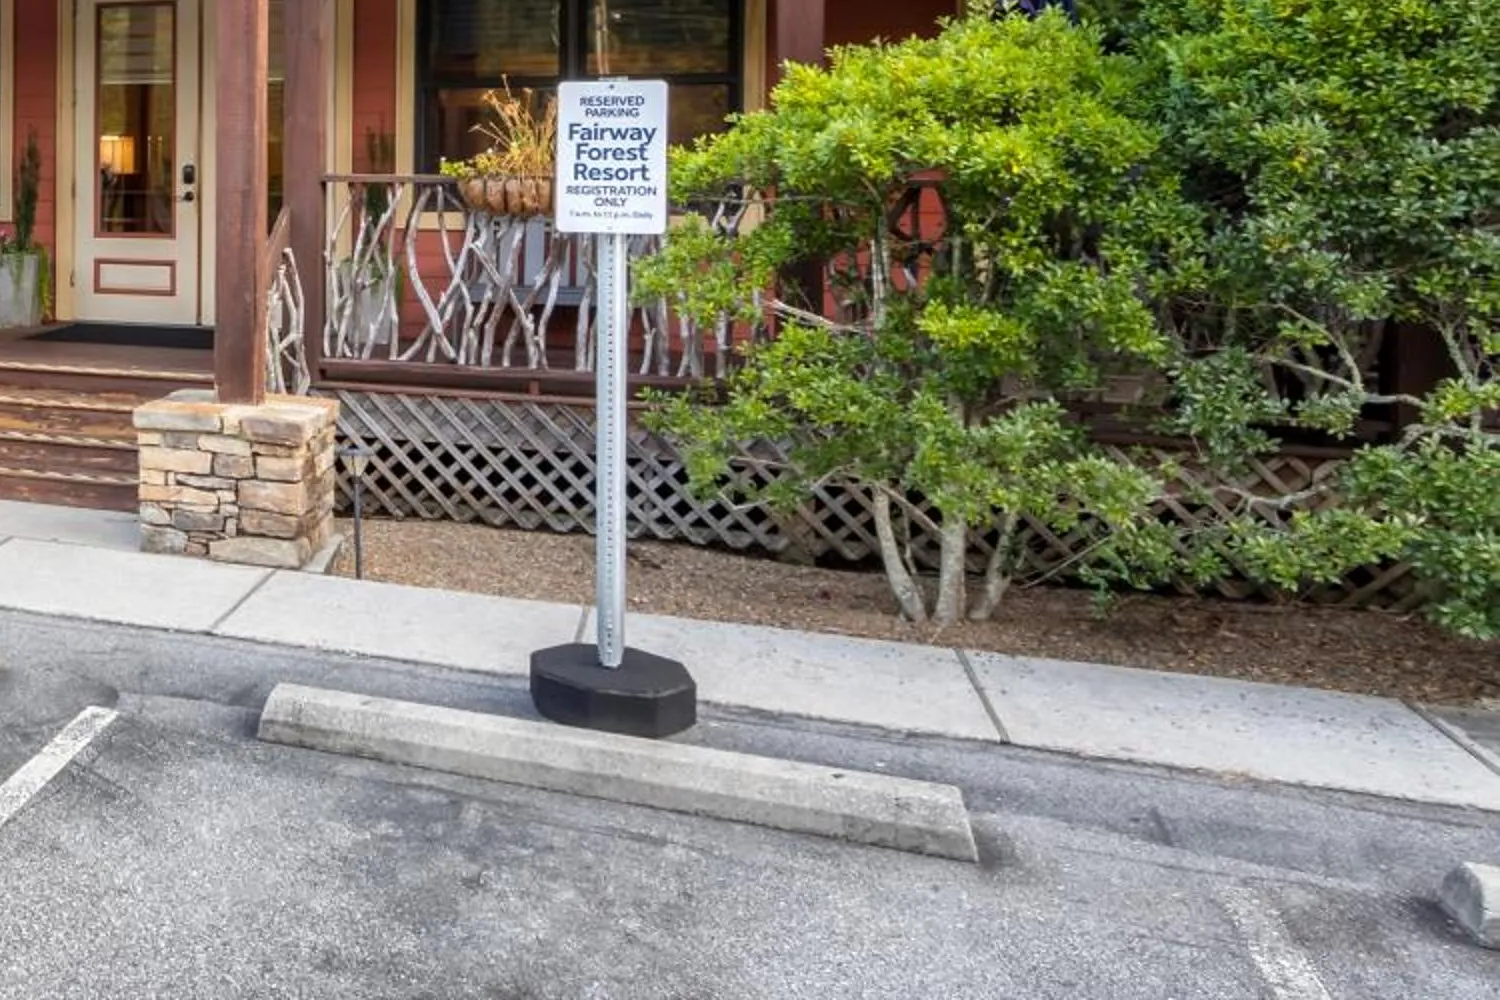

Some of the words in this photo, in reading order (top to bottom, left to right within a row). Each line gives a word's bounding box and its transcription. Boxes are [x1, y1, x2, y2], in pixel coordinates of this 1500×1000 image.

[579, 96, 645, 107] RESERVED
[585, 108, 640, 118] PARKING
[568, 123, 657, 146] Fairway
[576, 143, 649, 161] Forest
[573, 163, 651, 181] Resort
[565, 185, 657, 196] REGISTRATION
[594, 197, 627, 207] ONLY
